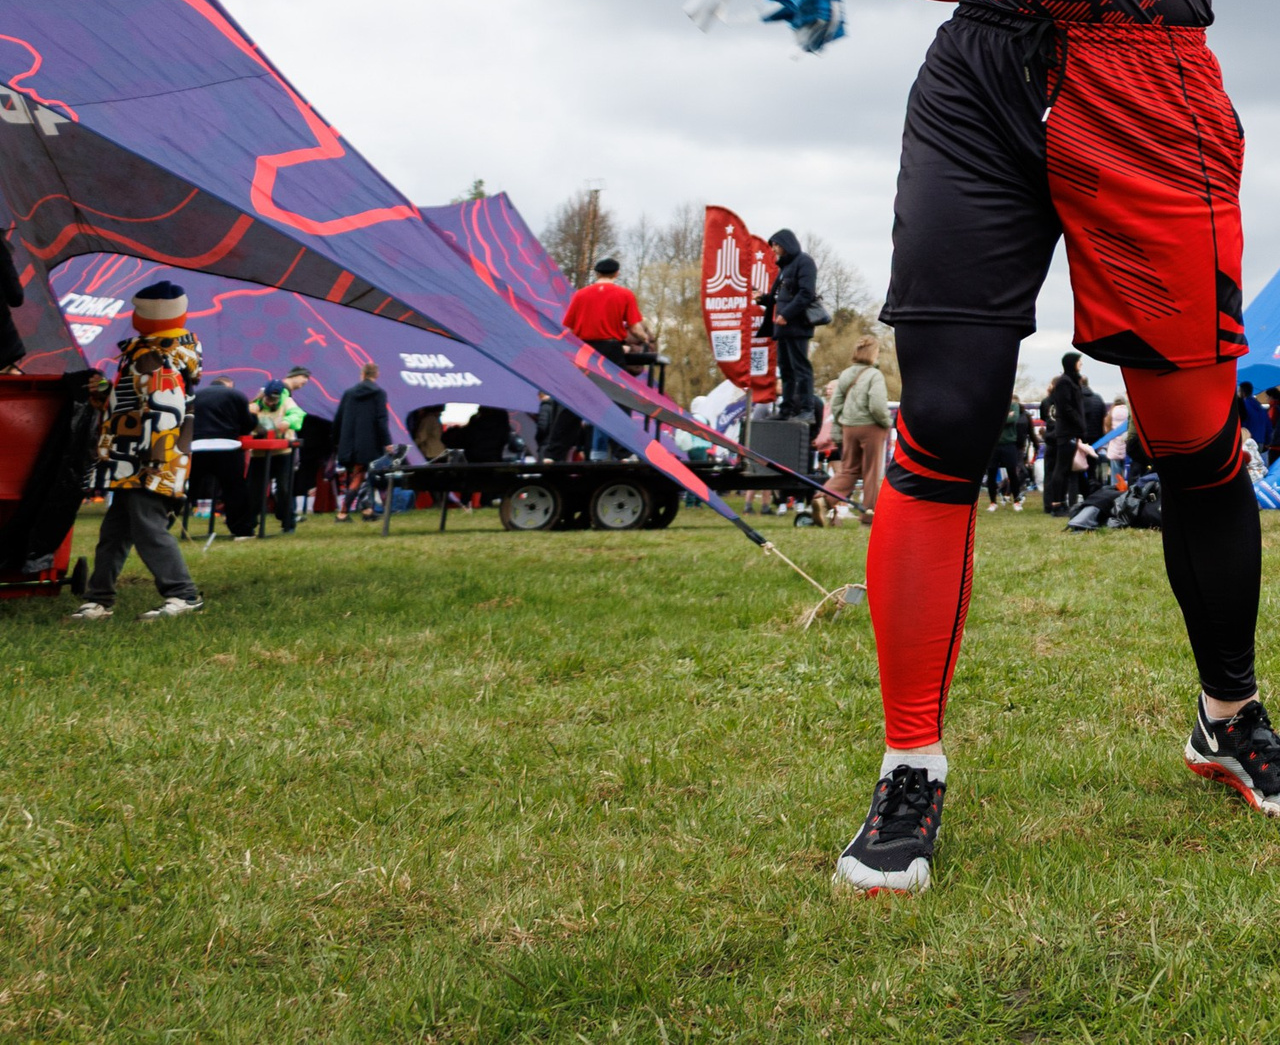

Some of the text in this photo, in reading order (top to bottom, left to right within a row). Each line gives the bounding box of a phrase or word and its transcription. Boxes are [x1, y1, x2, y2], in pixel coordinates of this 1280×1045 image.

[59, 293, 125, 319] ГОНКА
[705, 296, 748, 311] МОСАРМ
[399, 352, 455, 370] ЗОНА
[400, 370, 483, 390] ОТДЫХА
